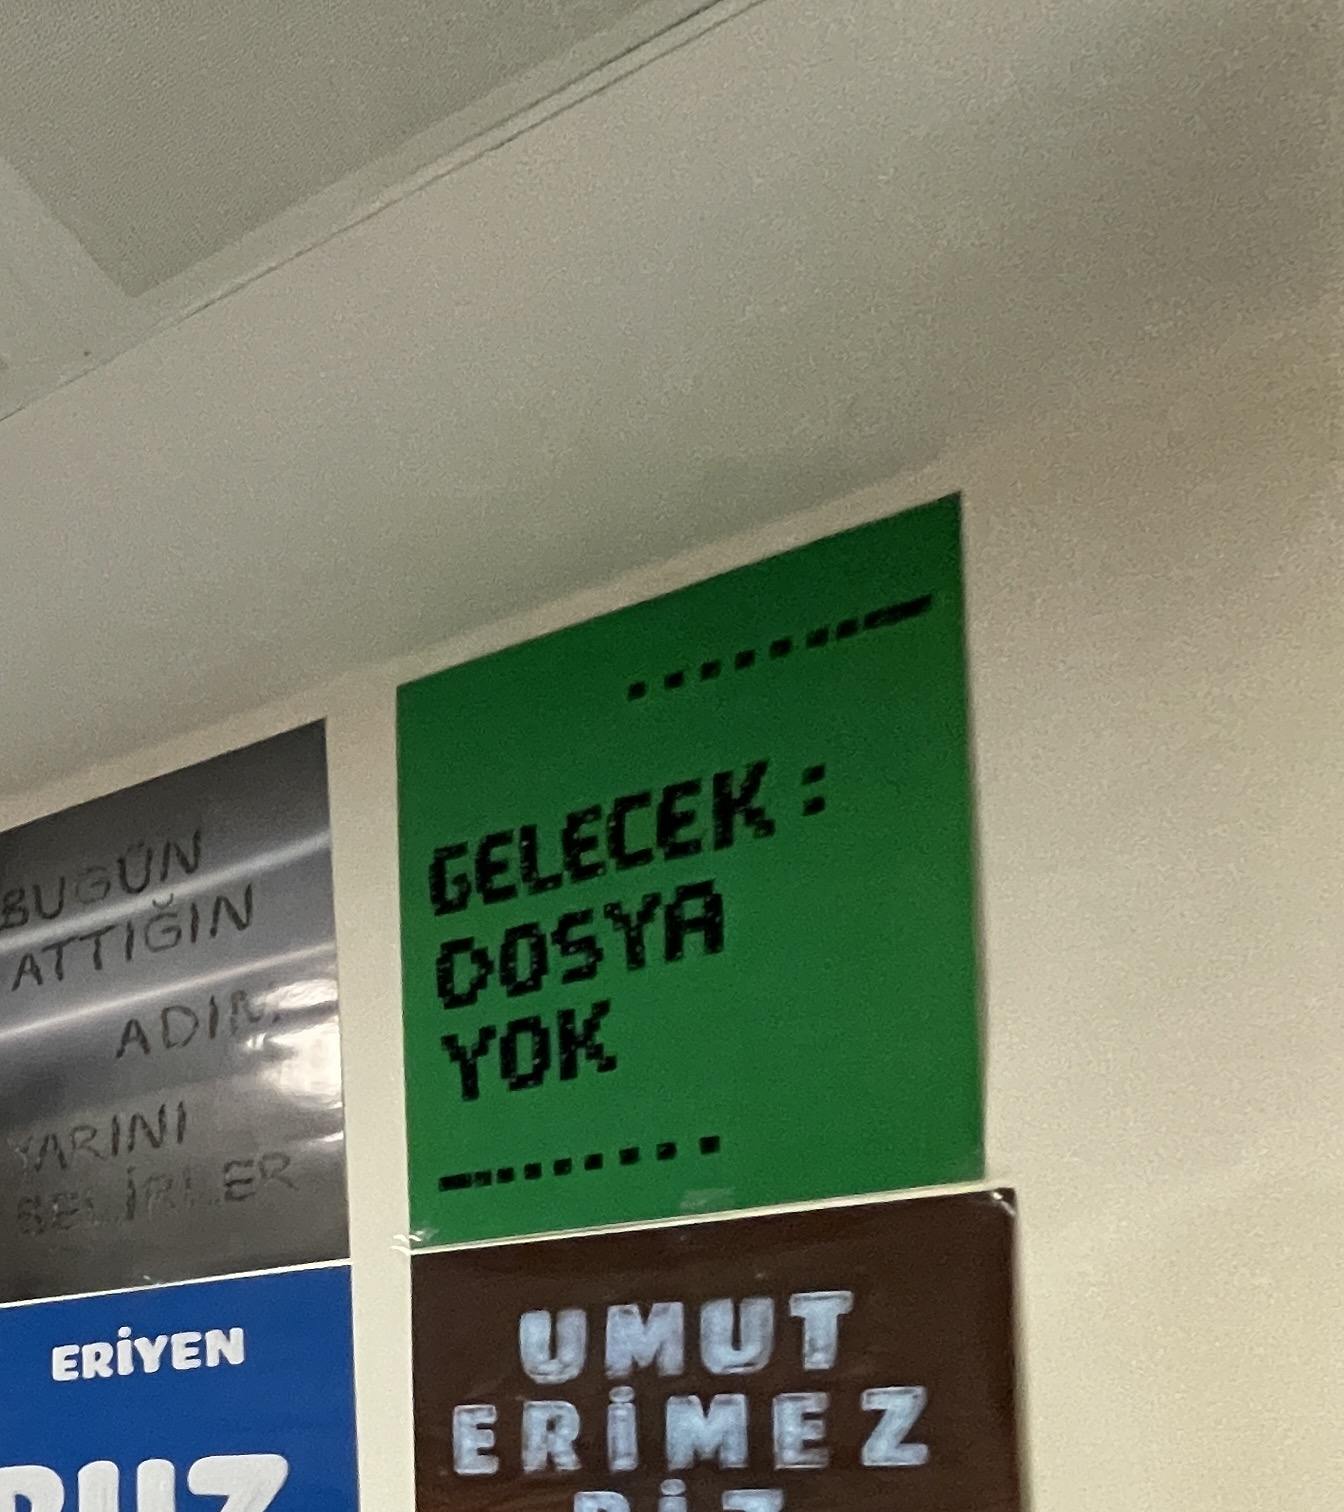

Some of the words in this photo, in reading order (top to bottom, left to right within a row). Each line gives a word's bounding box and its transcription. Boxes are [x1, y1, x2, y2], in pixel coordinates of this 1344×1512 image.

[427, 758, 775, 919] GELECEK
[11, 884, 254, 991] ATTIĞIN
[435, 878, 726, 1010] DOSYA
[440, 998, 618, 1103] YOK
[7, 1100, 187, 1173] YARINI
[51, 1326, 245, 1381] ERİYEN
[518, 1290, 854, 1385] UMUT
[451, 1385, 929, 1475] ERİMEZ
